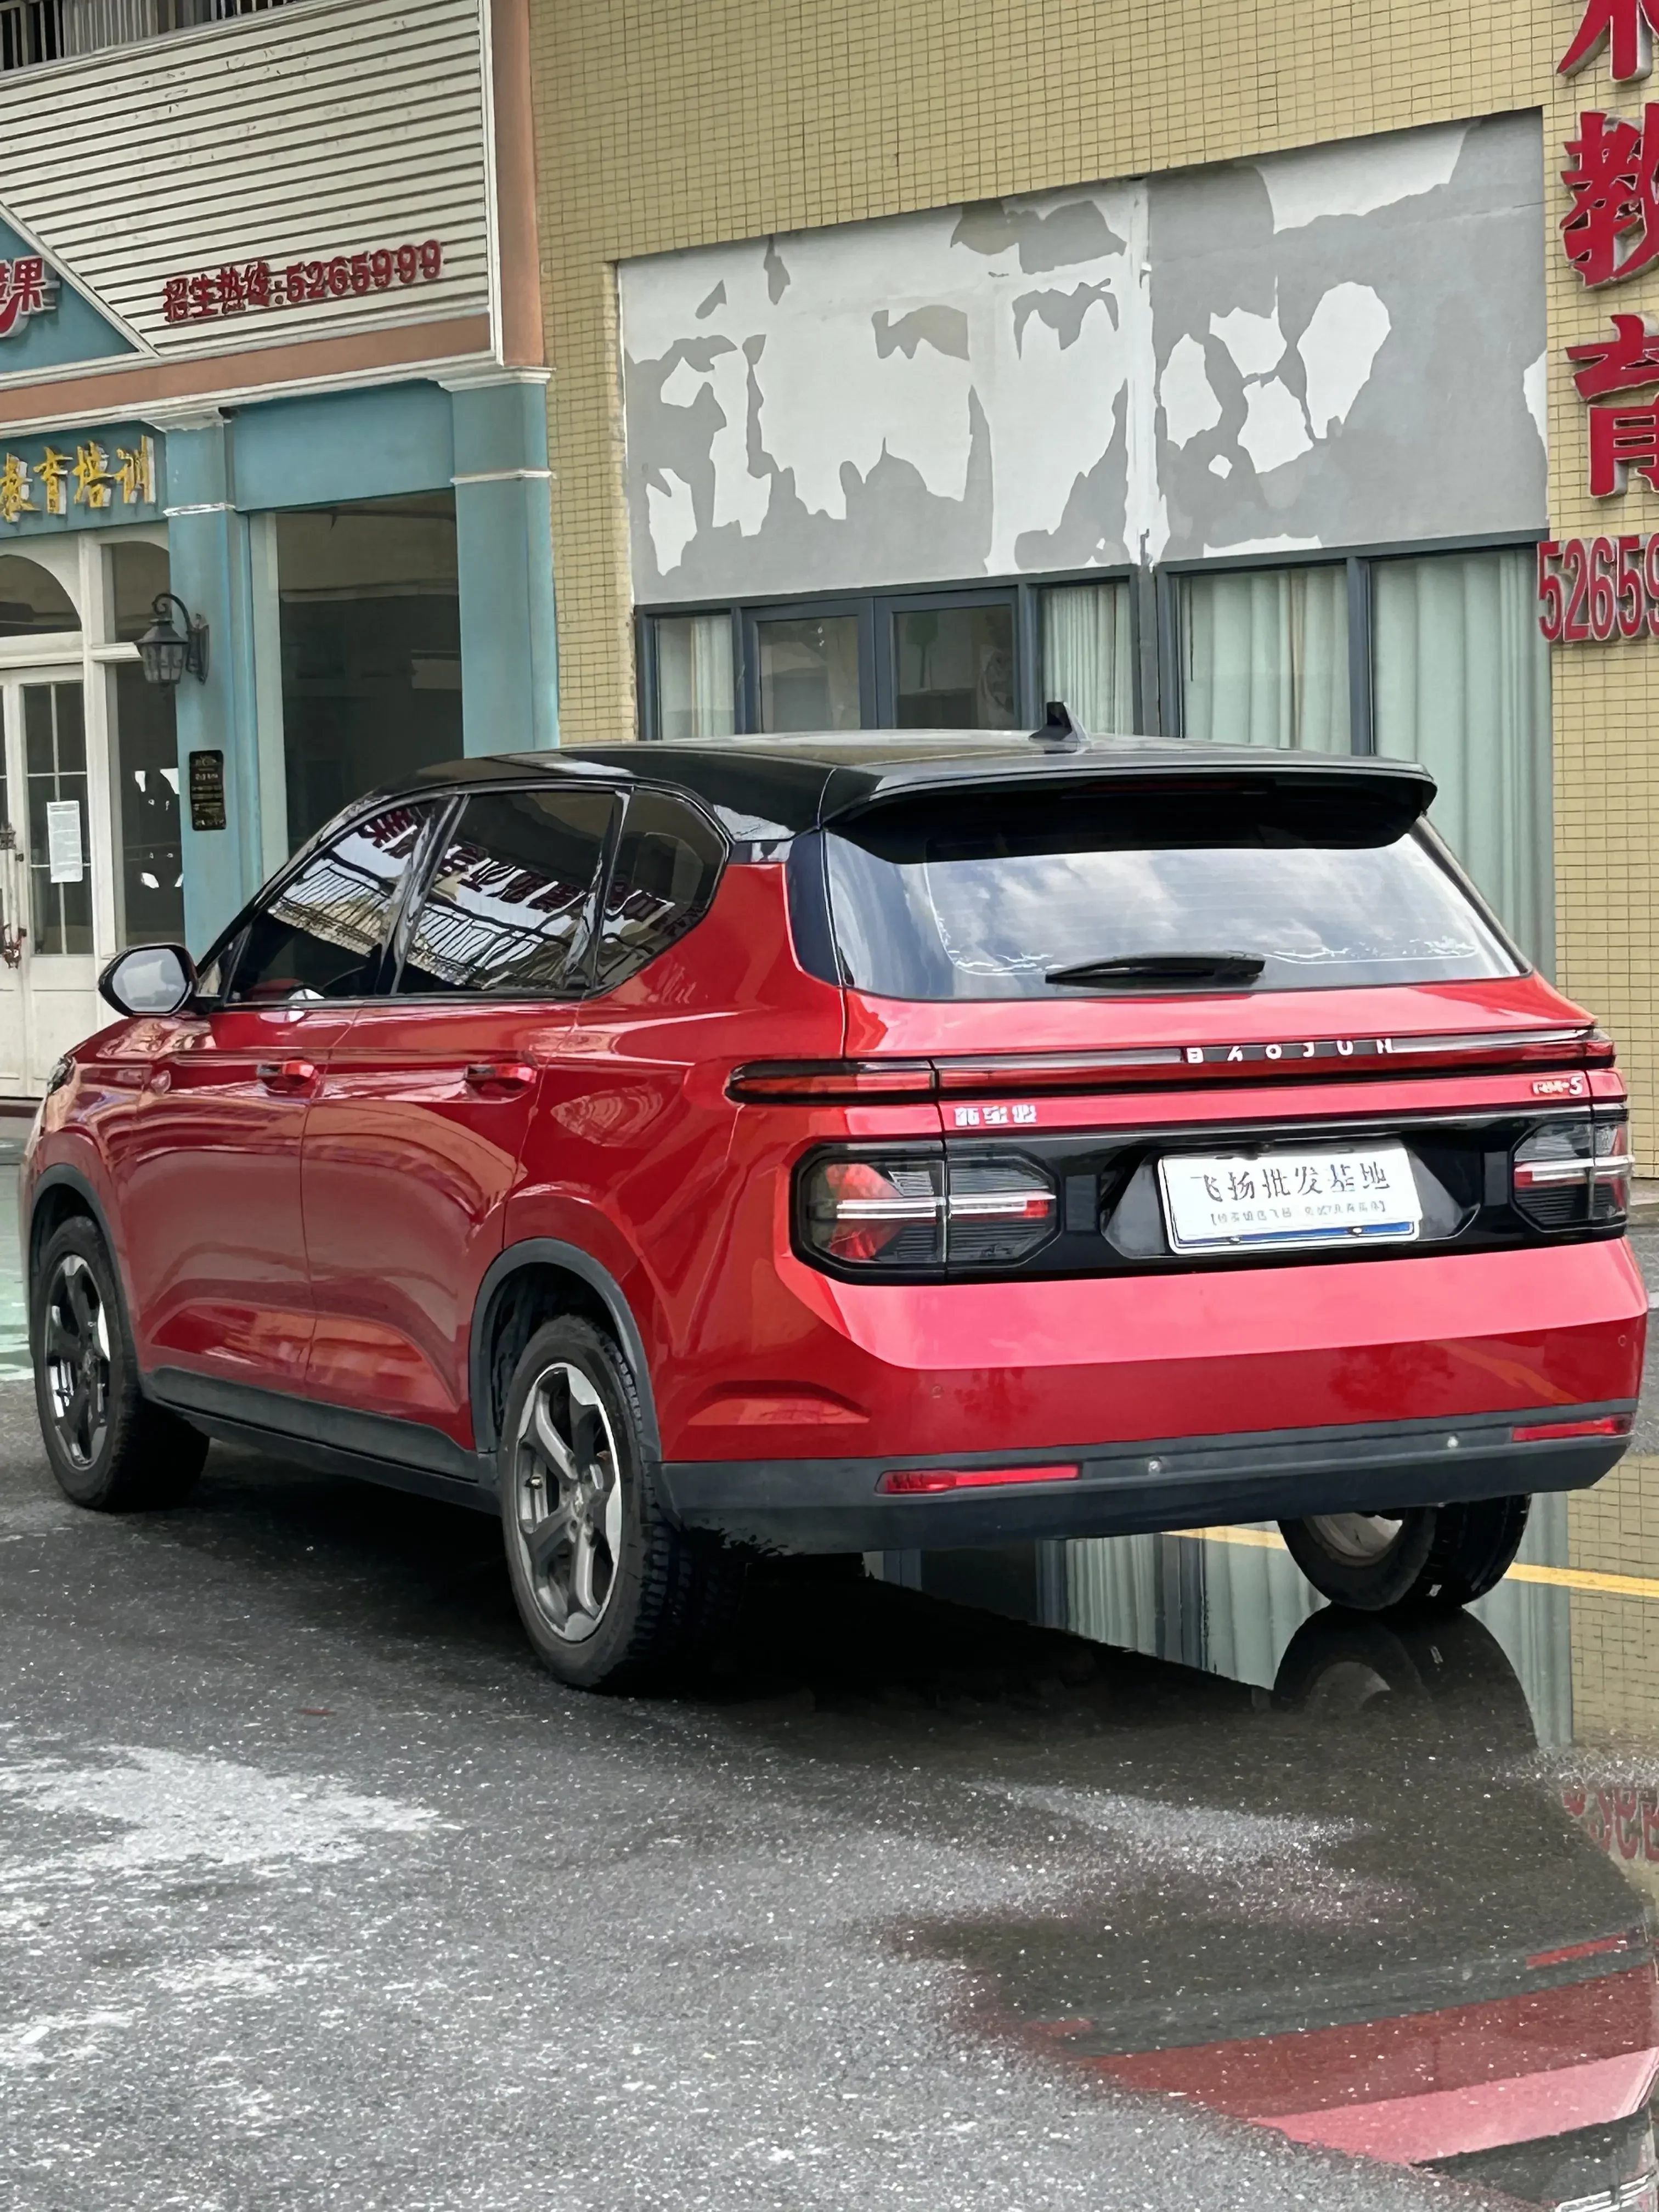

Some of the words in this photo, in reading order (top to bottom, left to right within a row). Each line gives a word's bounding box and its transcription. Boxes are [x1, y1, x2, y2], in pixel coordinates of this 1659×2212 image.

[1190, 1161, 1391, 1203] 飞扬批发基地
